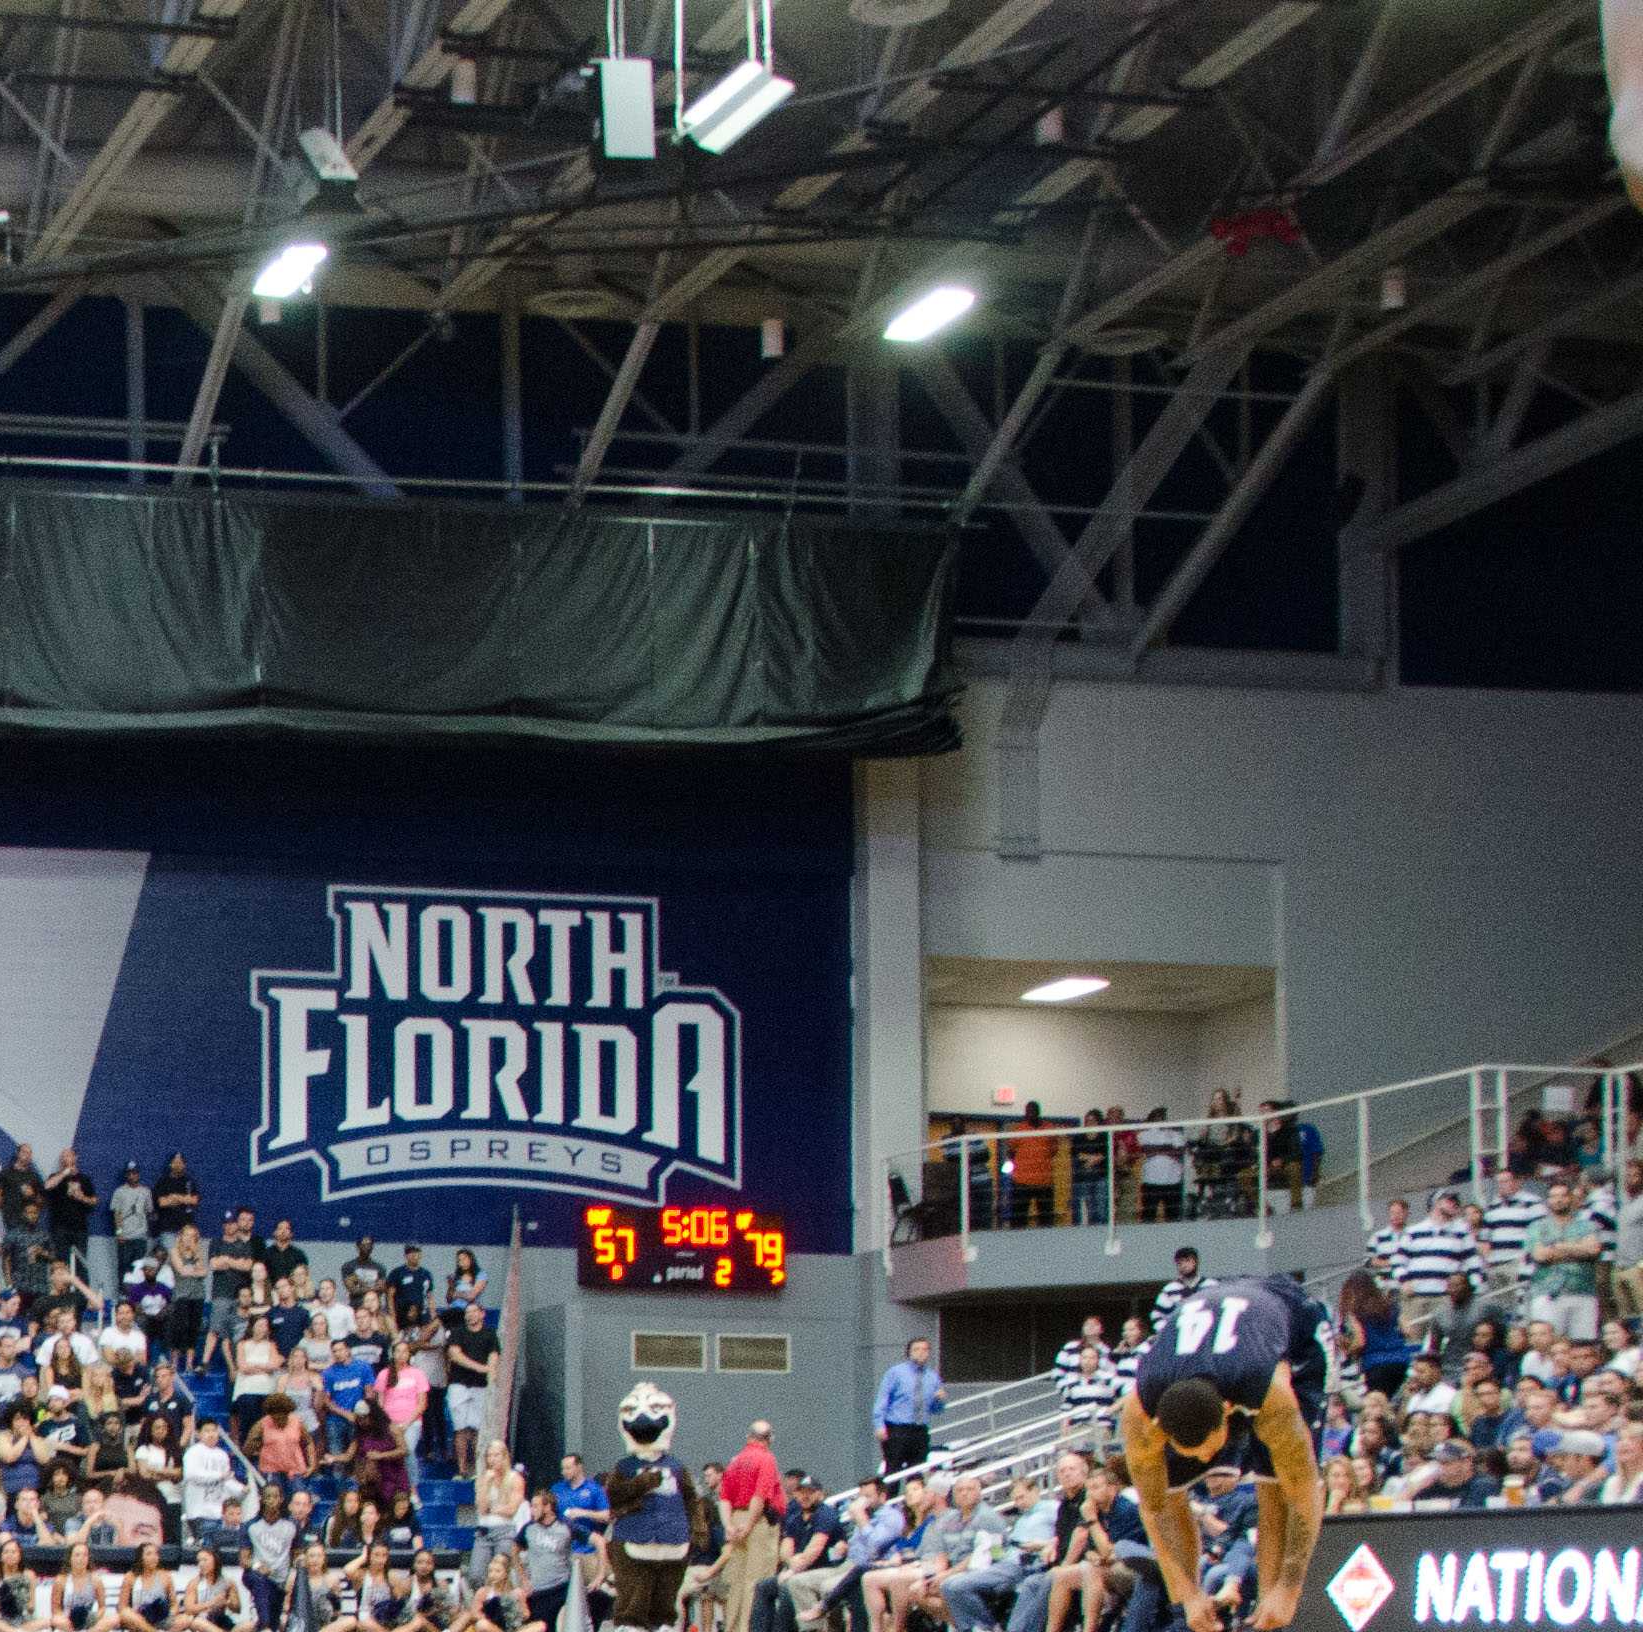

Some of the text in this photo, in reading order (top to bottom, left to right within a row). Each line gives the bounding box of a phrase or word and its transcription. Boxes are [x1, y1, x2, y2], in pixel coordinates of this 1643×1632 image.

[344, 901, 644, 1010] NORTH
[267, 987, 725, 1165] FLORIDA
[366, 1138, 623, 1175] OSPREYS
[595, 1228, 784, 1268] 57 79
[662, 1209, 729, 1245] 5:06
[666, 1258, 732, 1285] period 2
[1176, 1297, 1248, 1355] 14
[1413, 1549, 1643, 1625] NATION
